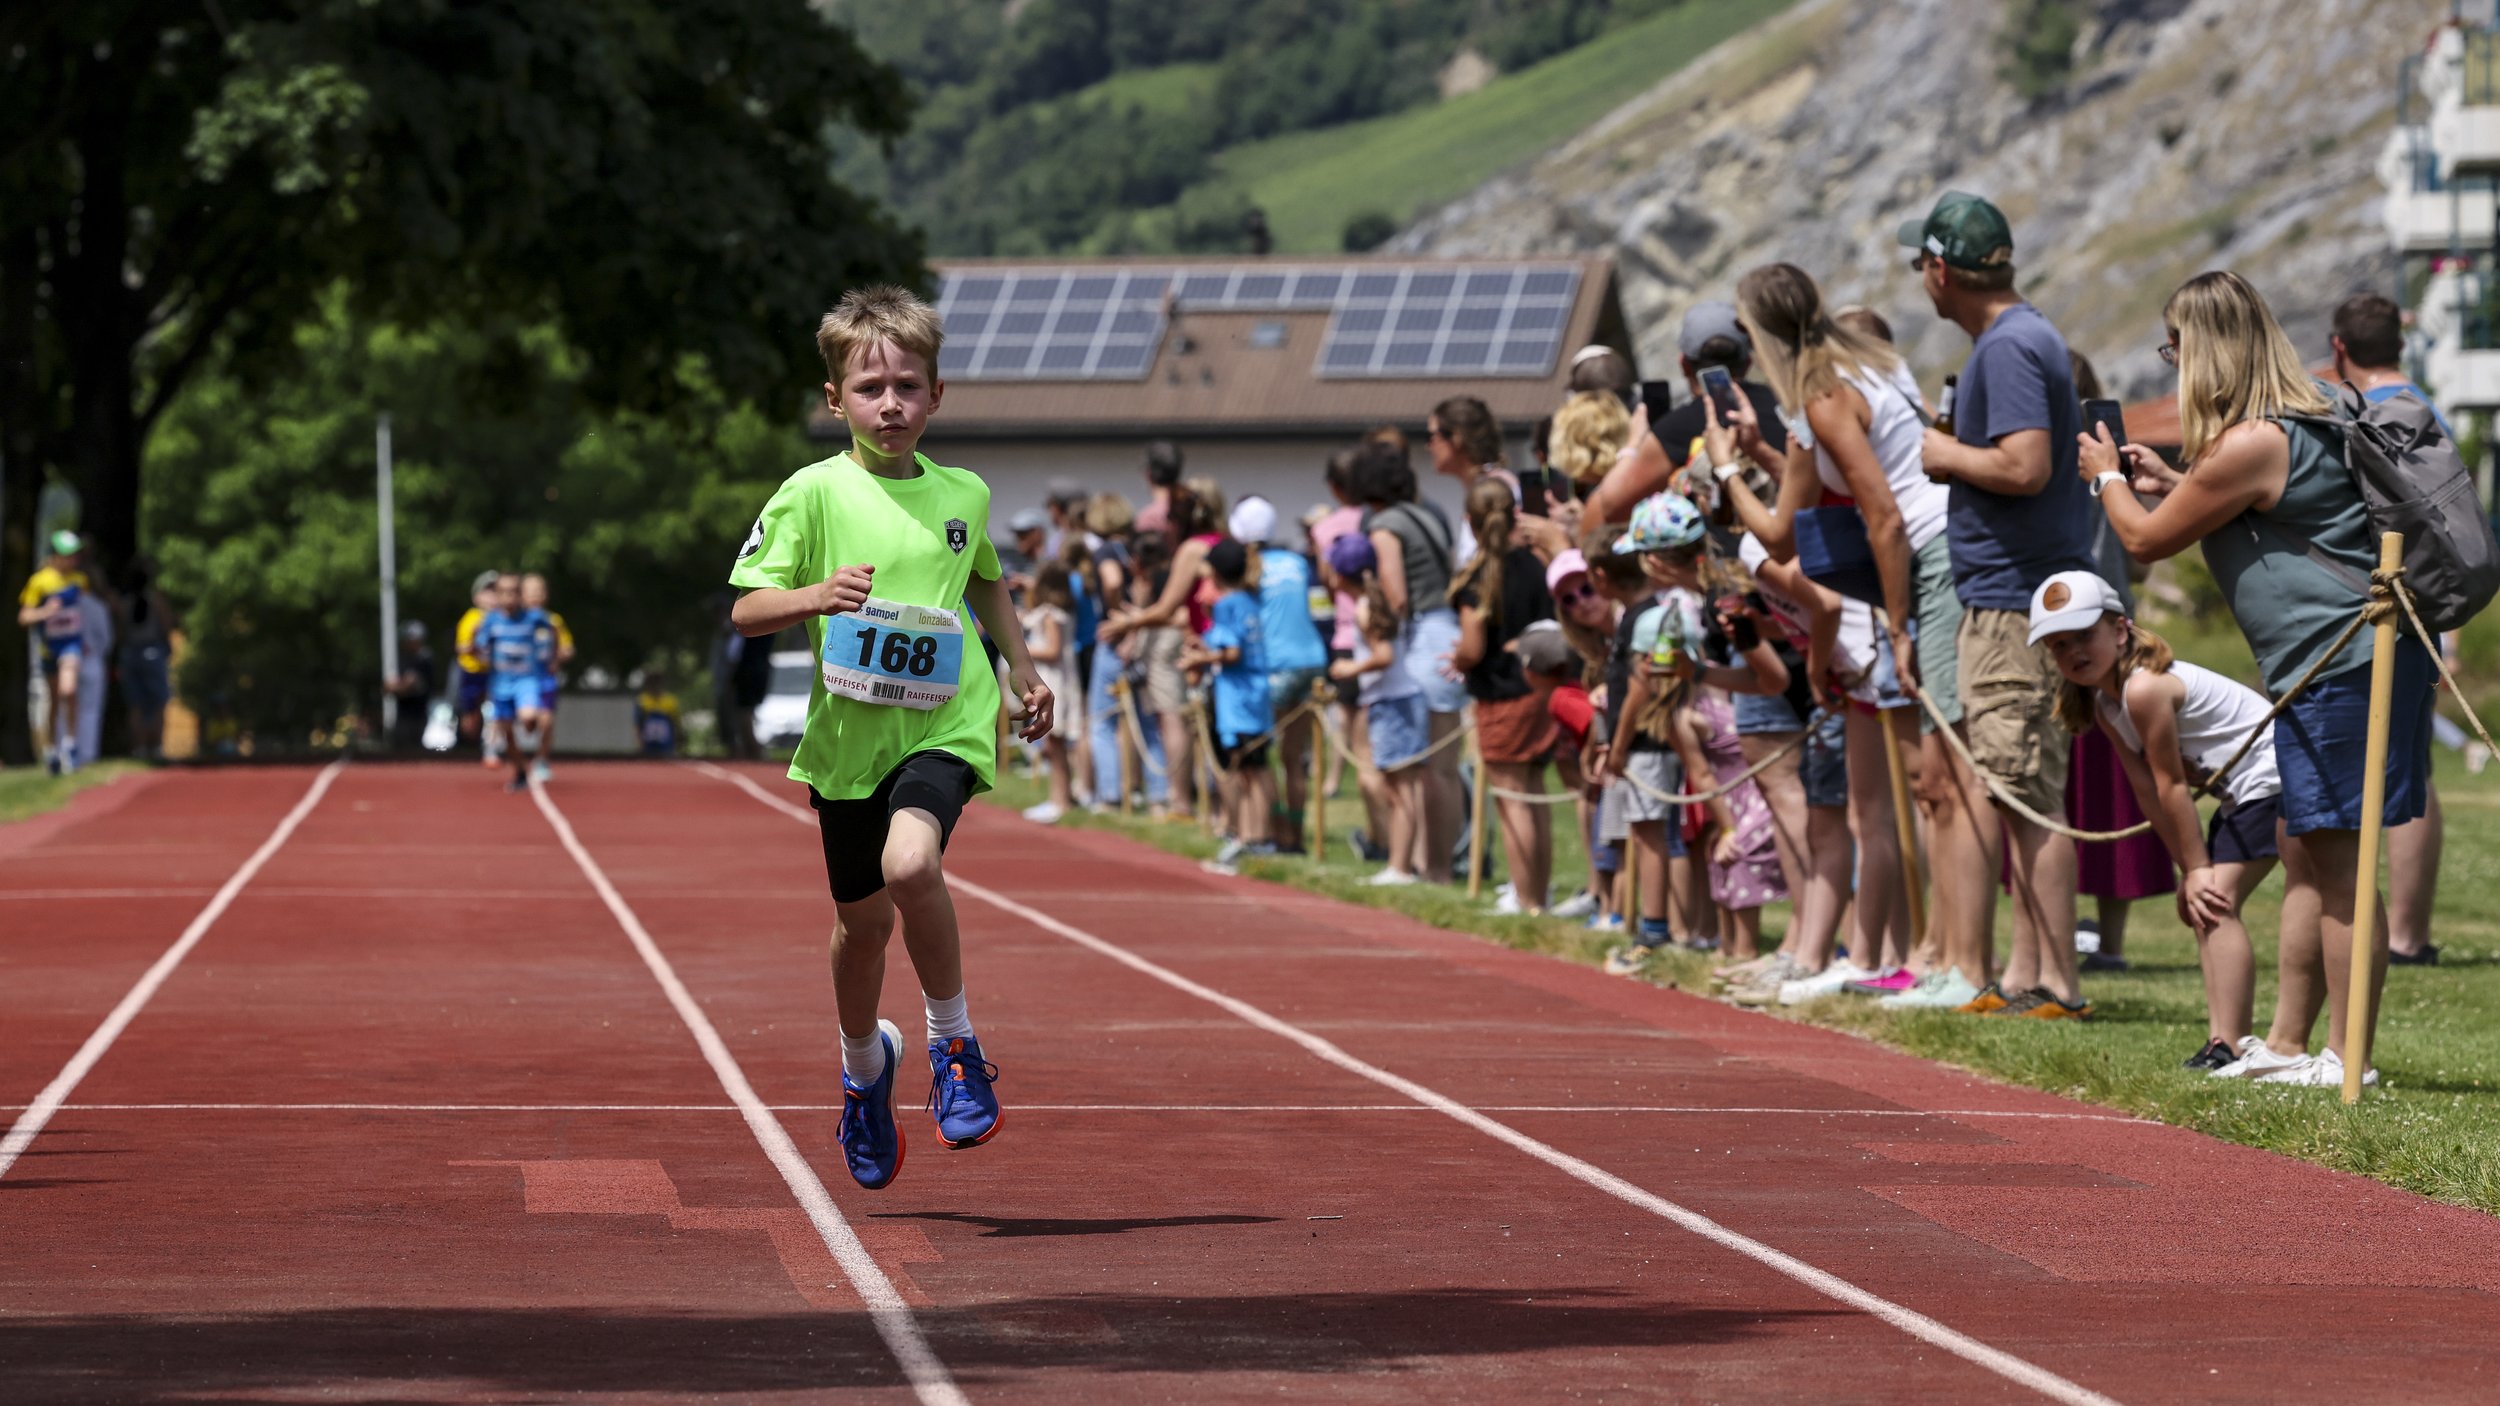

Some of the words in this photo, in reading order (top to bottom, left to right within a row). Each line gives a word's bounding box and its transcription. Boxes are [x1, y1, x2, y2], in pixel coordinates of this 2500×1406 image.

[865, 606, 899, 621] gampel
[856, 627, 937, 677] 168
[906, 690, 953, 704] RAIFFEISEN
